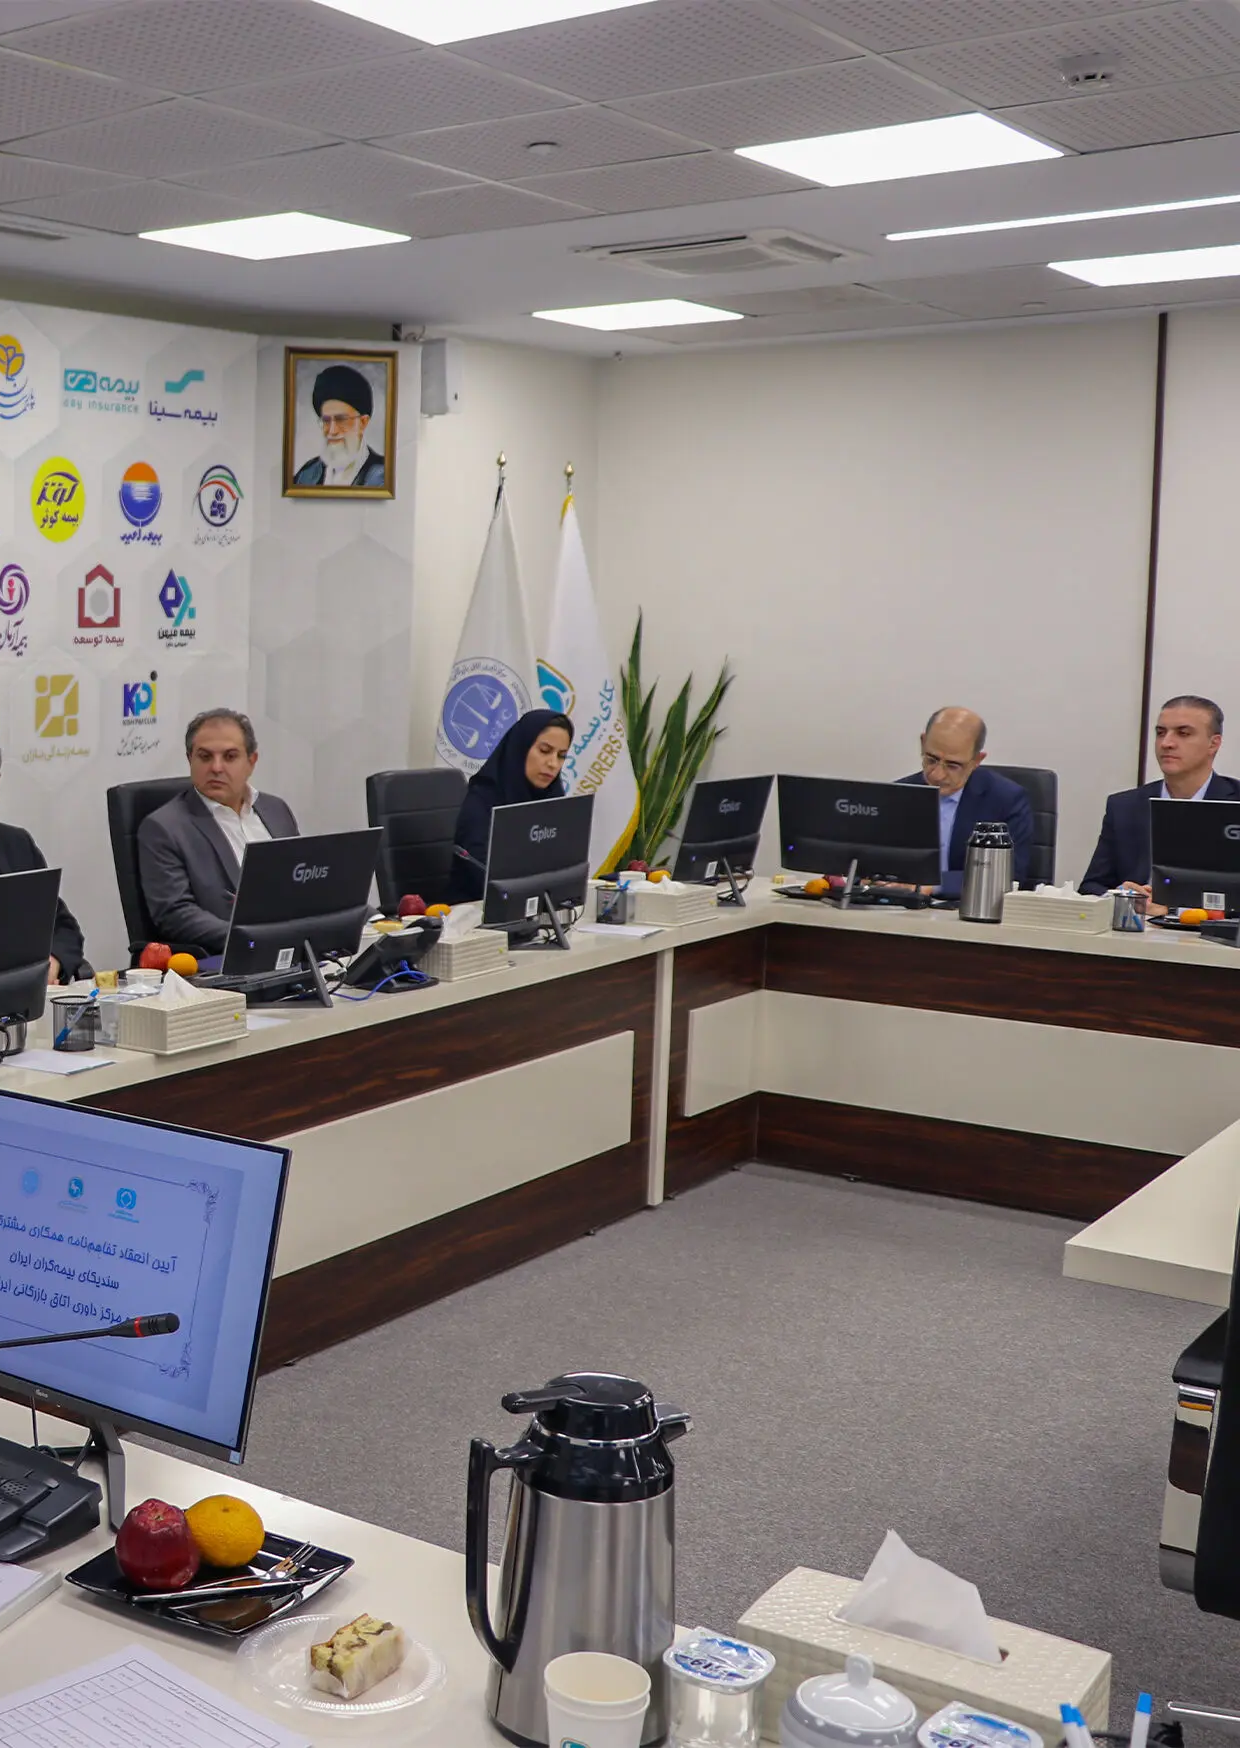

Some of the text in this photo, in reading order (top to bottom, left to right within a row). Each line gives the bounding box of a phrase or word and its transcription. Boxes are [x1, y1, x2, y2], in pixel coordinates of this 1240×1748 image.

[99, 377, 140, 402] بیمه
[149, 400, 218, 427] بیمه سینا
[62, 512, 79, 528] بیمه
[73, 634, 125, 648] بیمه توسعه
[179, 627, 197, 638] بیمه
[835, 798, 879, 816] Gplus
[530, 824, 557, 843] Gplus
[292, 862, 329, 884] Gplus
[29, 1226, 64, 1243] همکاری
[9, 1250, 32, 1268] ایران
[120, 1250, 150, 1266] انعقاد
[152, 1256, 178, 1274] آیین
[78, 1269, 120, 1290] سندیکای
[13, 1283, 48, 1304] بازرگانی
[50, 1293, 71, 1309] اتاق
[72, 1299, 98, 1318] داوری
[100, 1304, 123, 1323] مرکز
